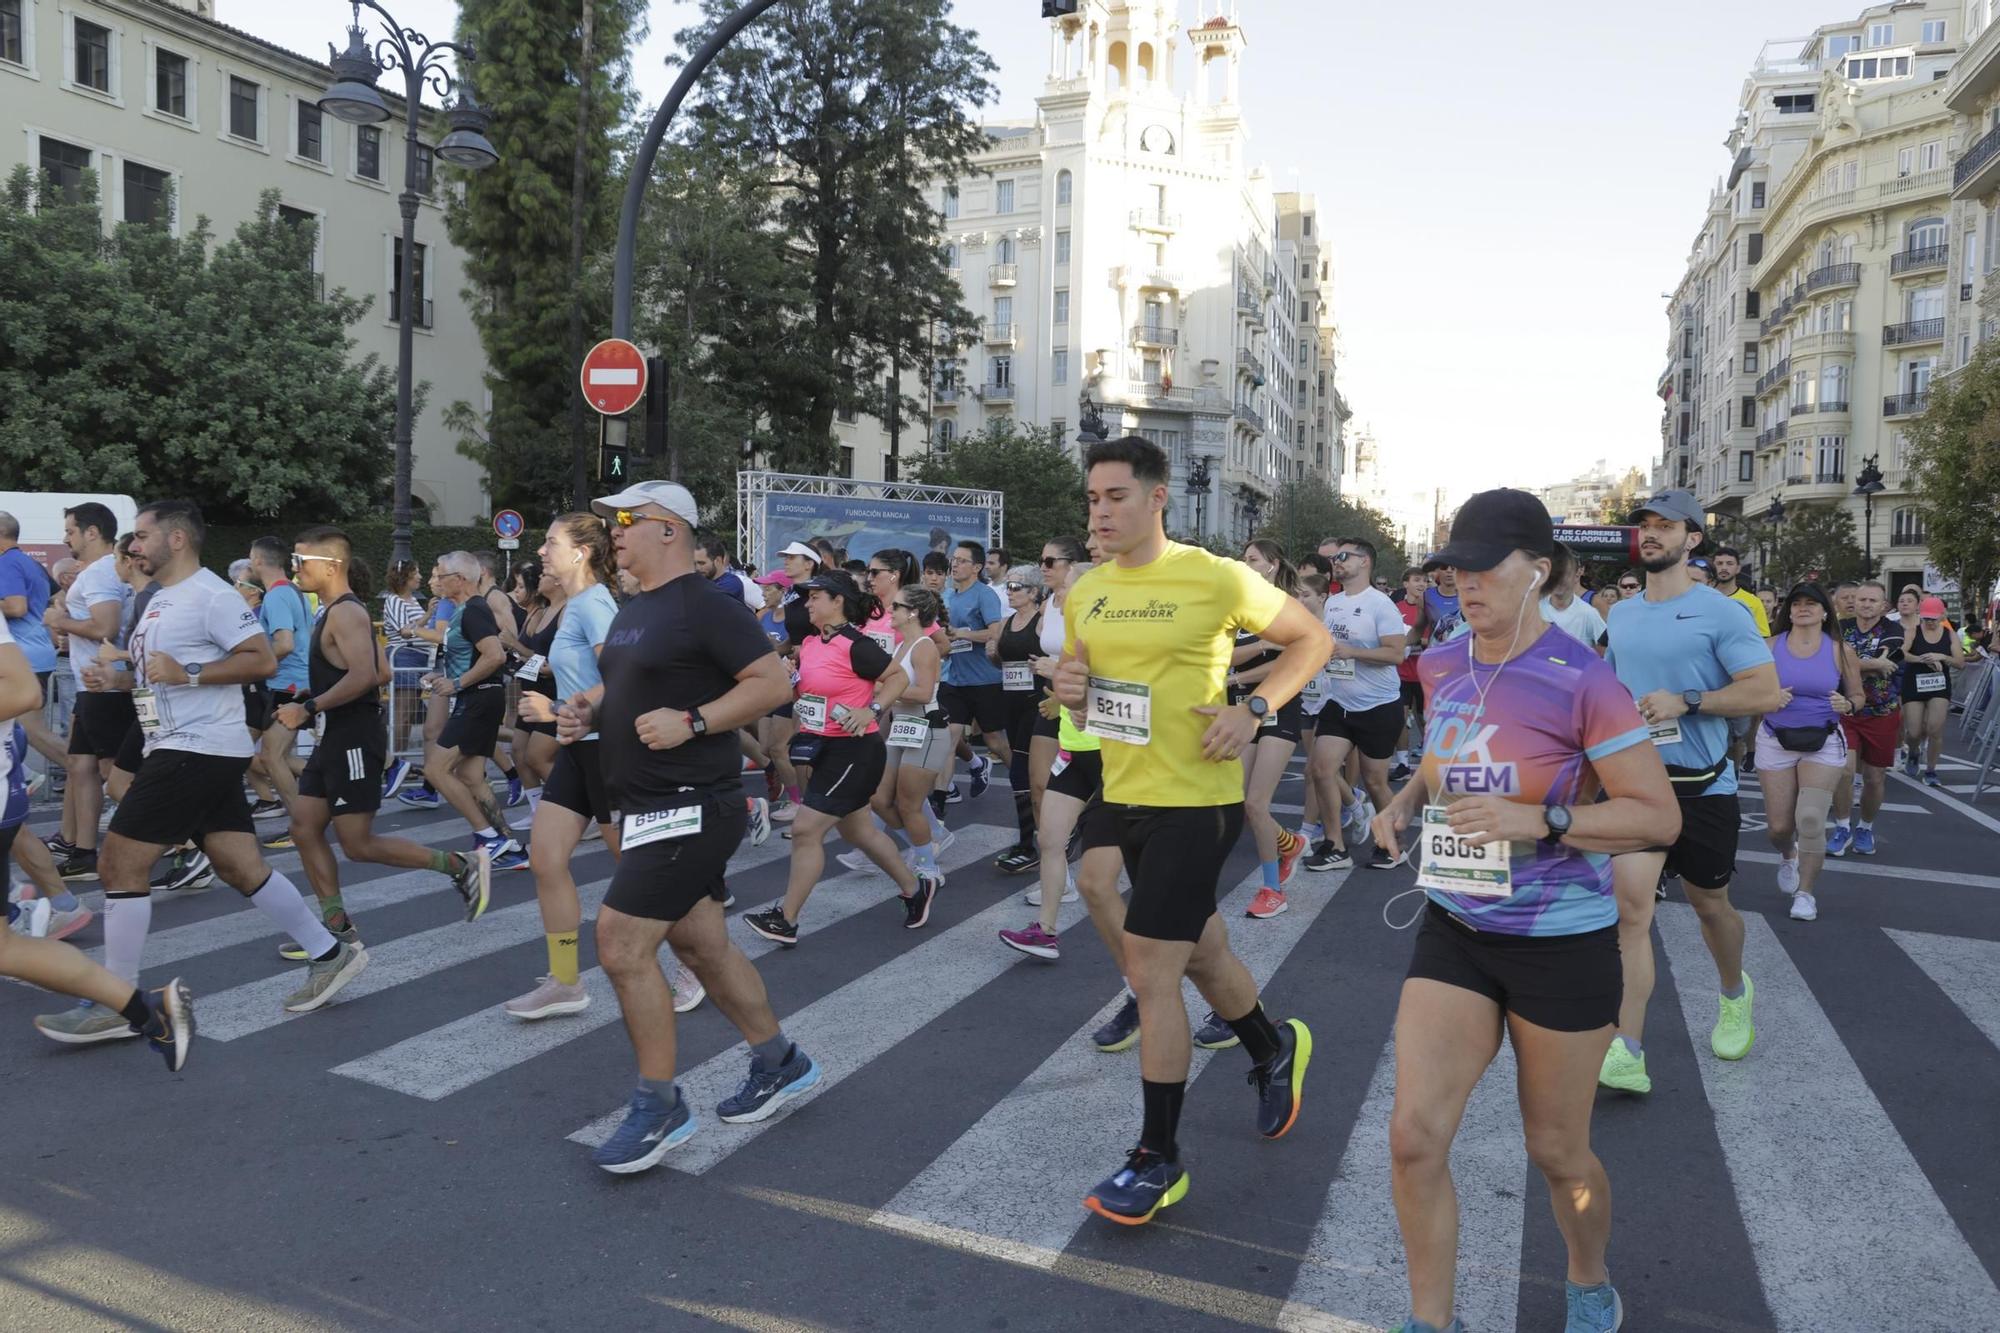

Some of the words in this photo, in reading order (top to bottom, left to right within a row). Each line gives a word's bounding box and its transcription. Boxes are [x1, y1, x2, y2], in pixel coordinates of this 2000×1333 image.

[776, 504, 816, 514] EXPOSICIÓN
[845, 508, 882, 518] FUNDACIÓN
[882, 511, 910, 520] BANCAJA
[1574, 529, 1622, 537] CARRERES
[1104, 609, 1174, 619] CLOCKWORK
[1096, 696, 1132, 720] 5211
[893, 724, 916, 736] 6386
[1423, 715, 1500, 764] 10K
[1446, 765, 1512, 793] FEM
